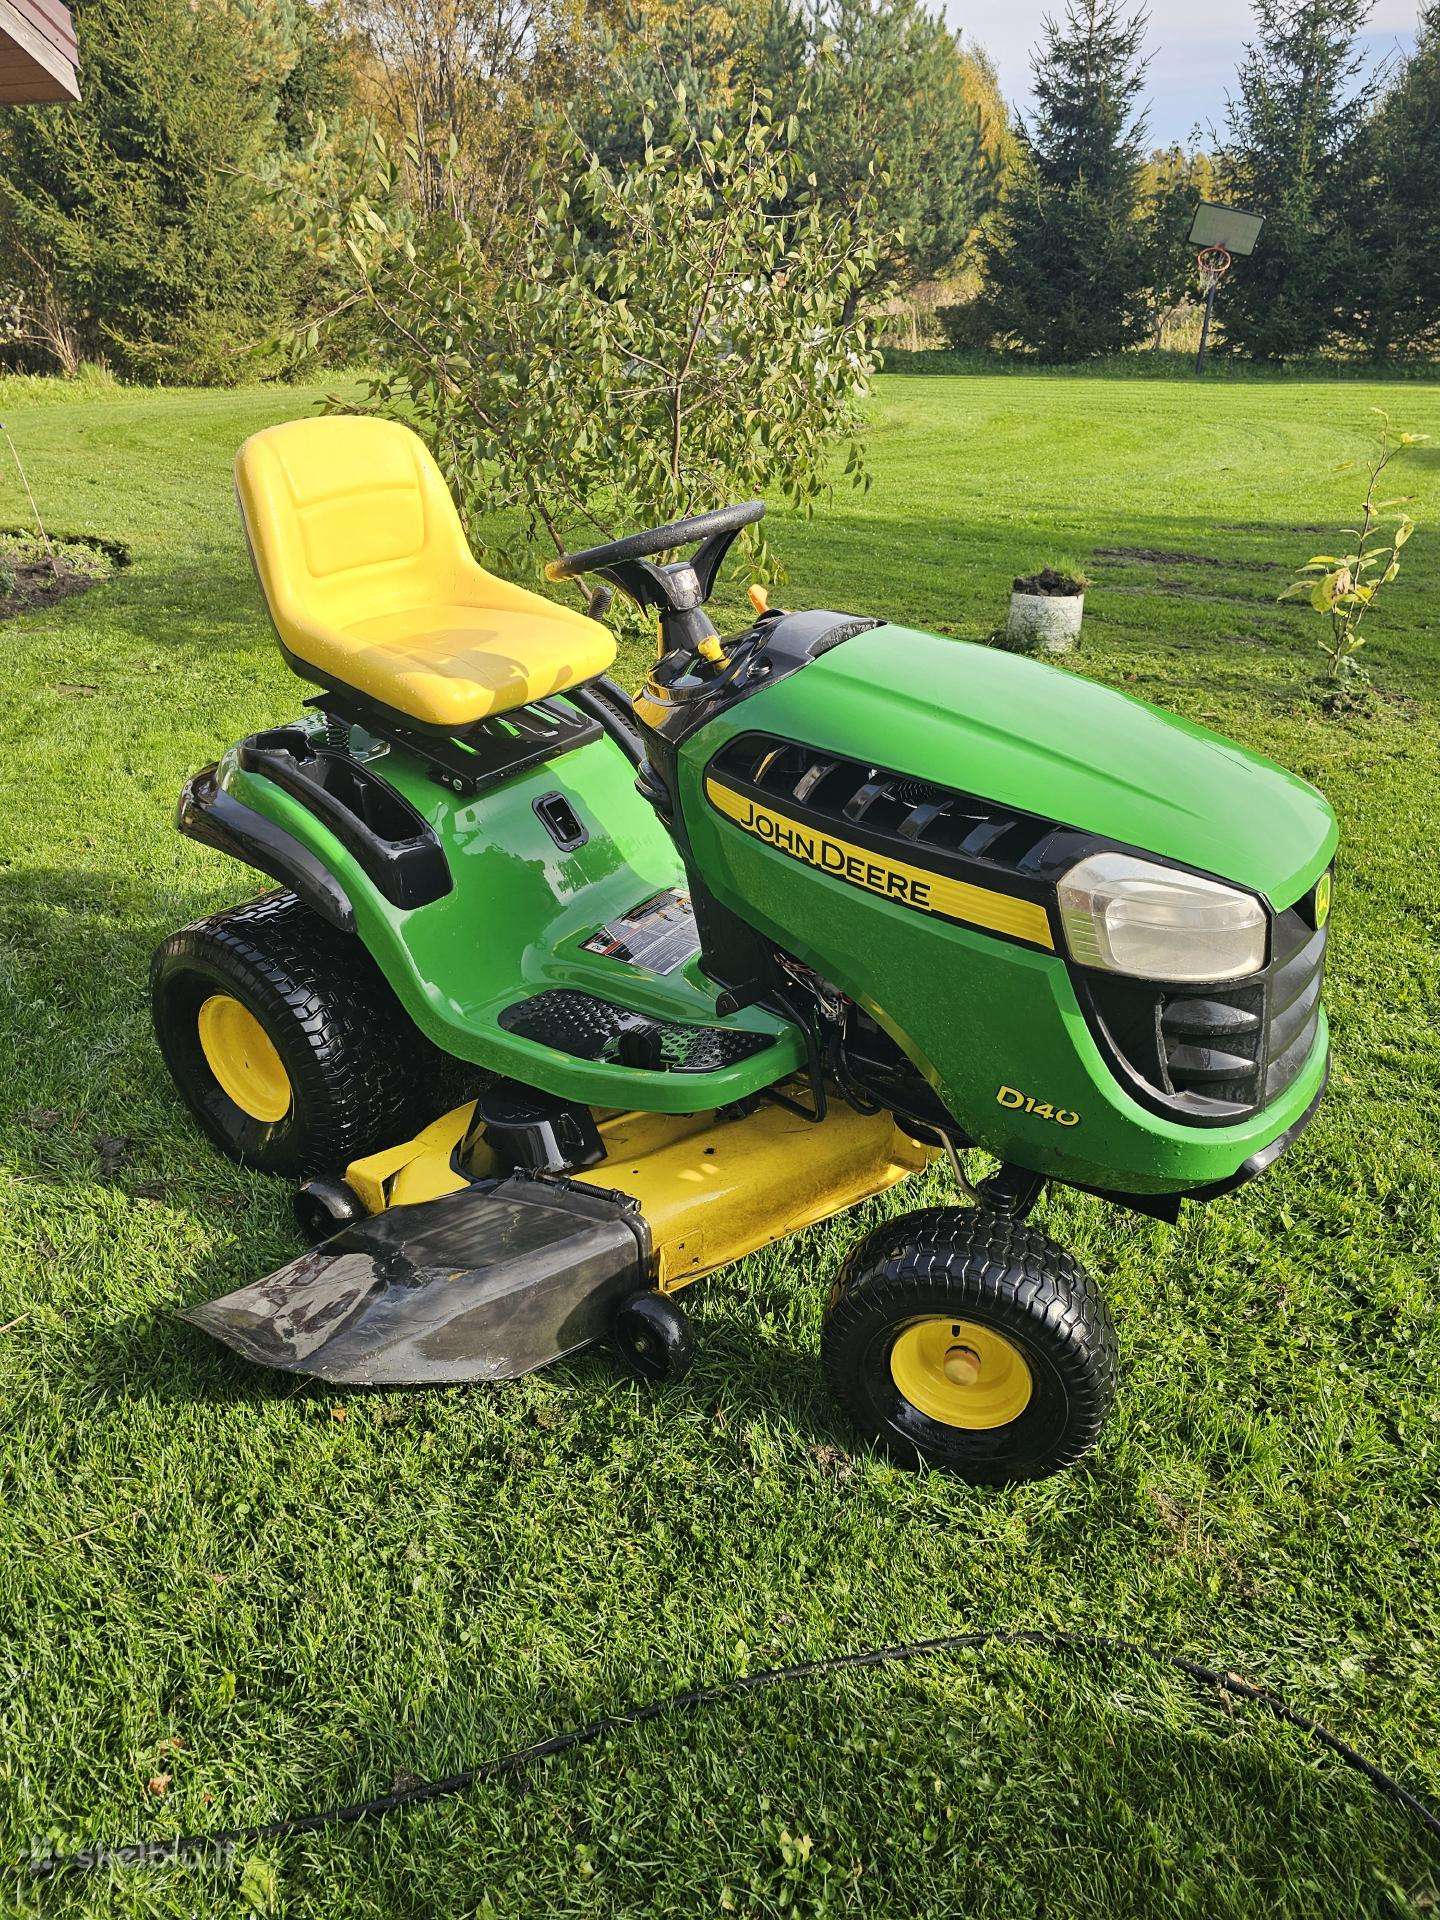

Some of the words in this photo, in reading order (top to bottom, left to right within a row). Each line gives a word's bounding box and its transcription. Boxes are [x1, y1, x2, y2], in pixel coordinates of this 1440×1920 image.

[740, 804, 815, 862] JOHN
[821, 839, 931, 907] DEERE
[996, 1085, 1080, 1126] D140
